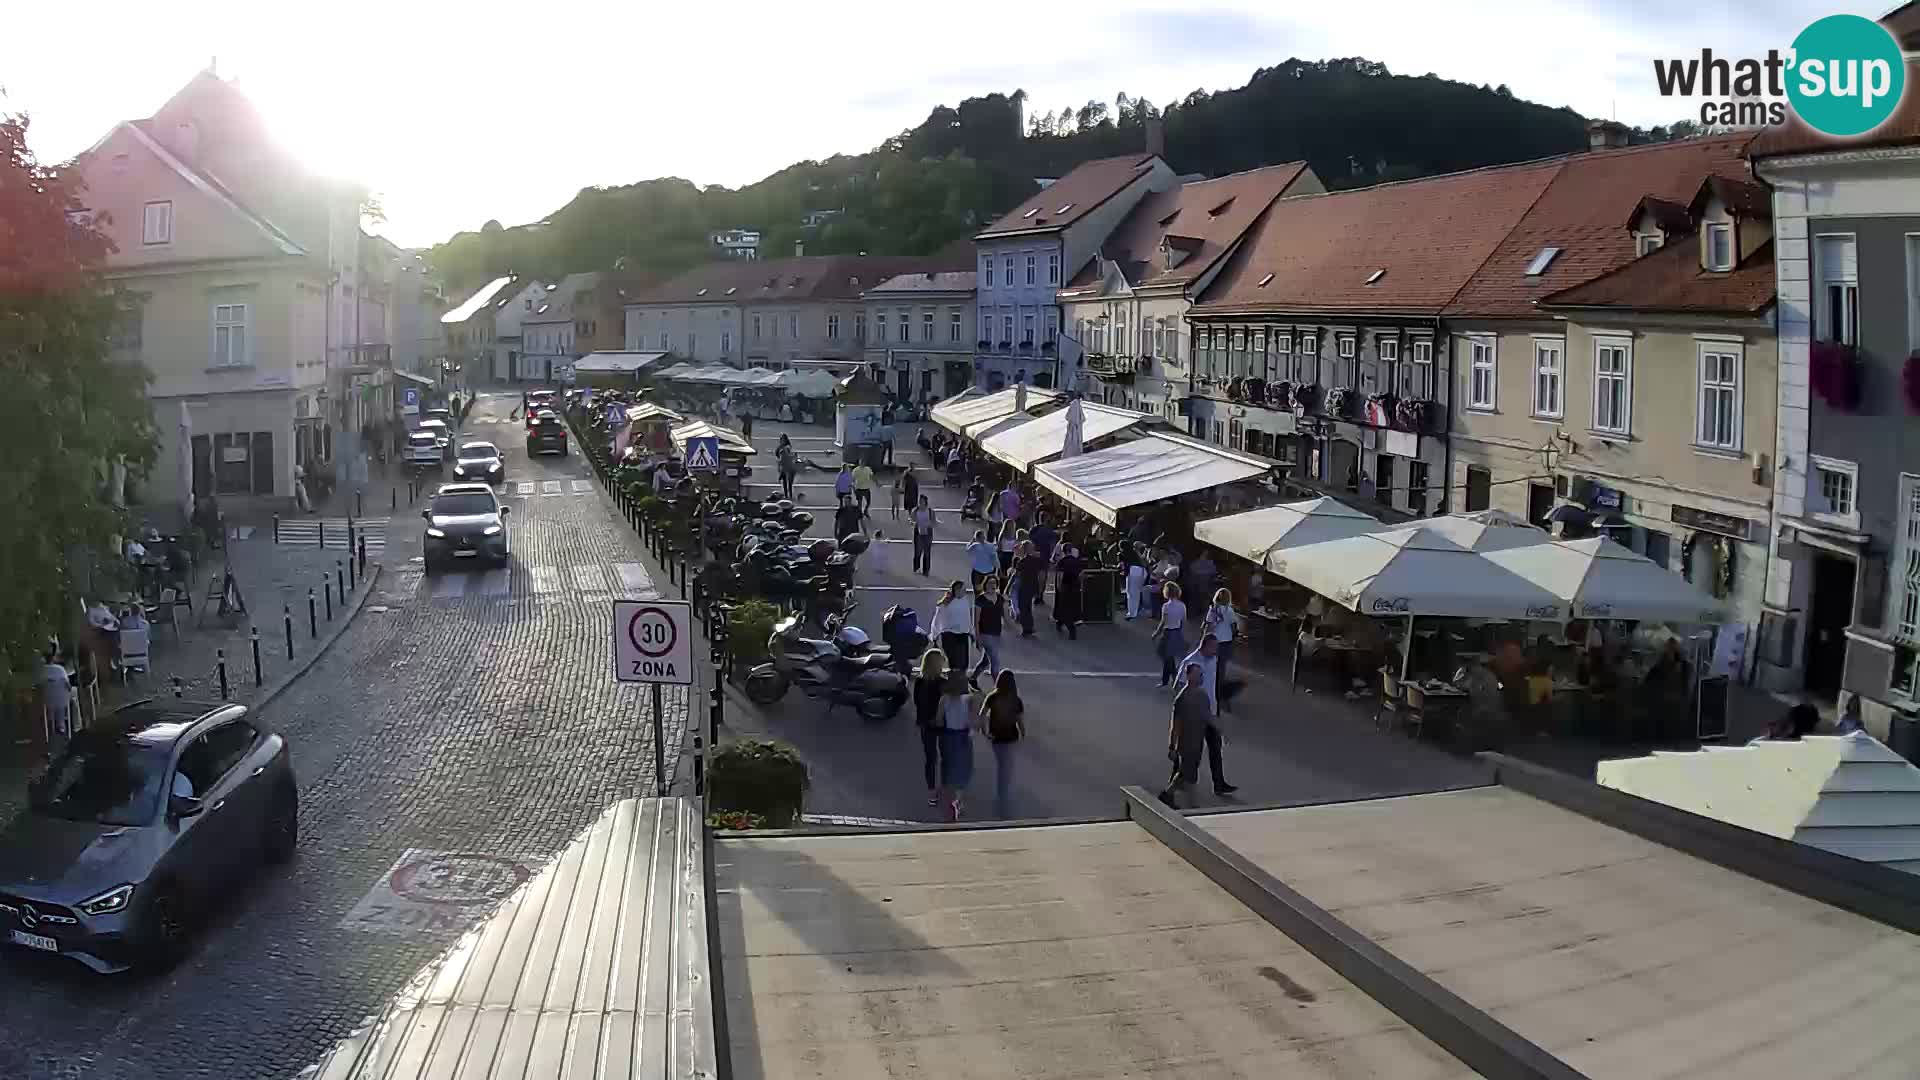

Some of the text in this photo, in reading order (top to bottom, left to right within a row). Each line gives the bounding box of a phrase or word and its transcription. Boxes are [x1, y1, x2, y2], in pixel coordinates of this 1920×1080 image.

[407, 391, 416, 402] P
[641, 623, 665, 644] 30
[631, 660, 677, 677] ZONA
